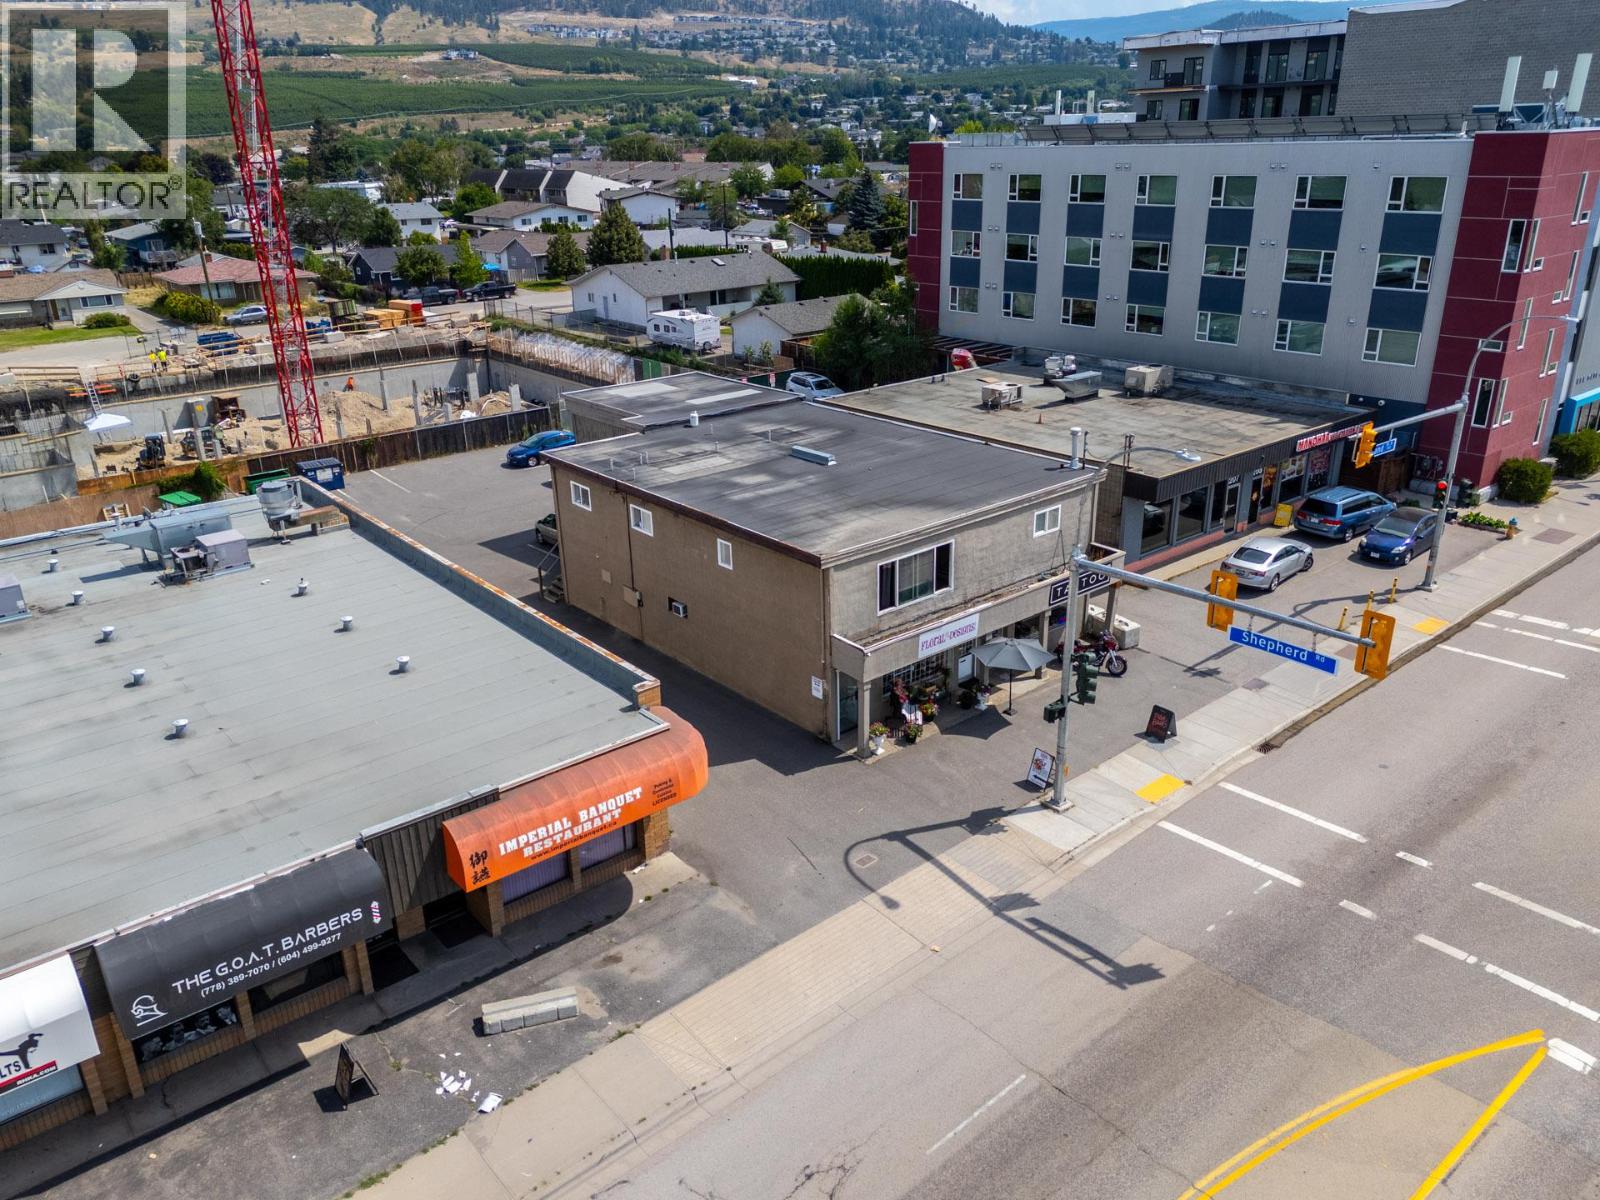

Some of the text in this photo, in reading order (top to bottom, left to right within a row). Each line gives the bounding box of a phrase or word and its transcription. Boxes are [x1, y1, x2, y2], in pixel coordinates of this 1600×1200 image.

[1056, 571, 1106, 597] TATOO
[1242, 631, 1325, 663] Shepherd Rd
[498, 786, 642, 856] IMPERIAL BANQUET
[523, 808, 621, 858] RESTAURANT
[171, 908, 363, 994] THE G.O.A.T. BARBERS
[201, 981, 225, 998] (778)
[227, 963, 270, 986] 389-7070
[277, 950, 300, 966] (604)
[302, 932, 342, 954] 499-9277
